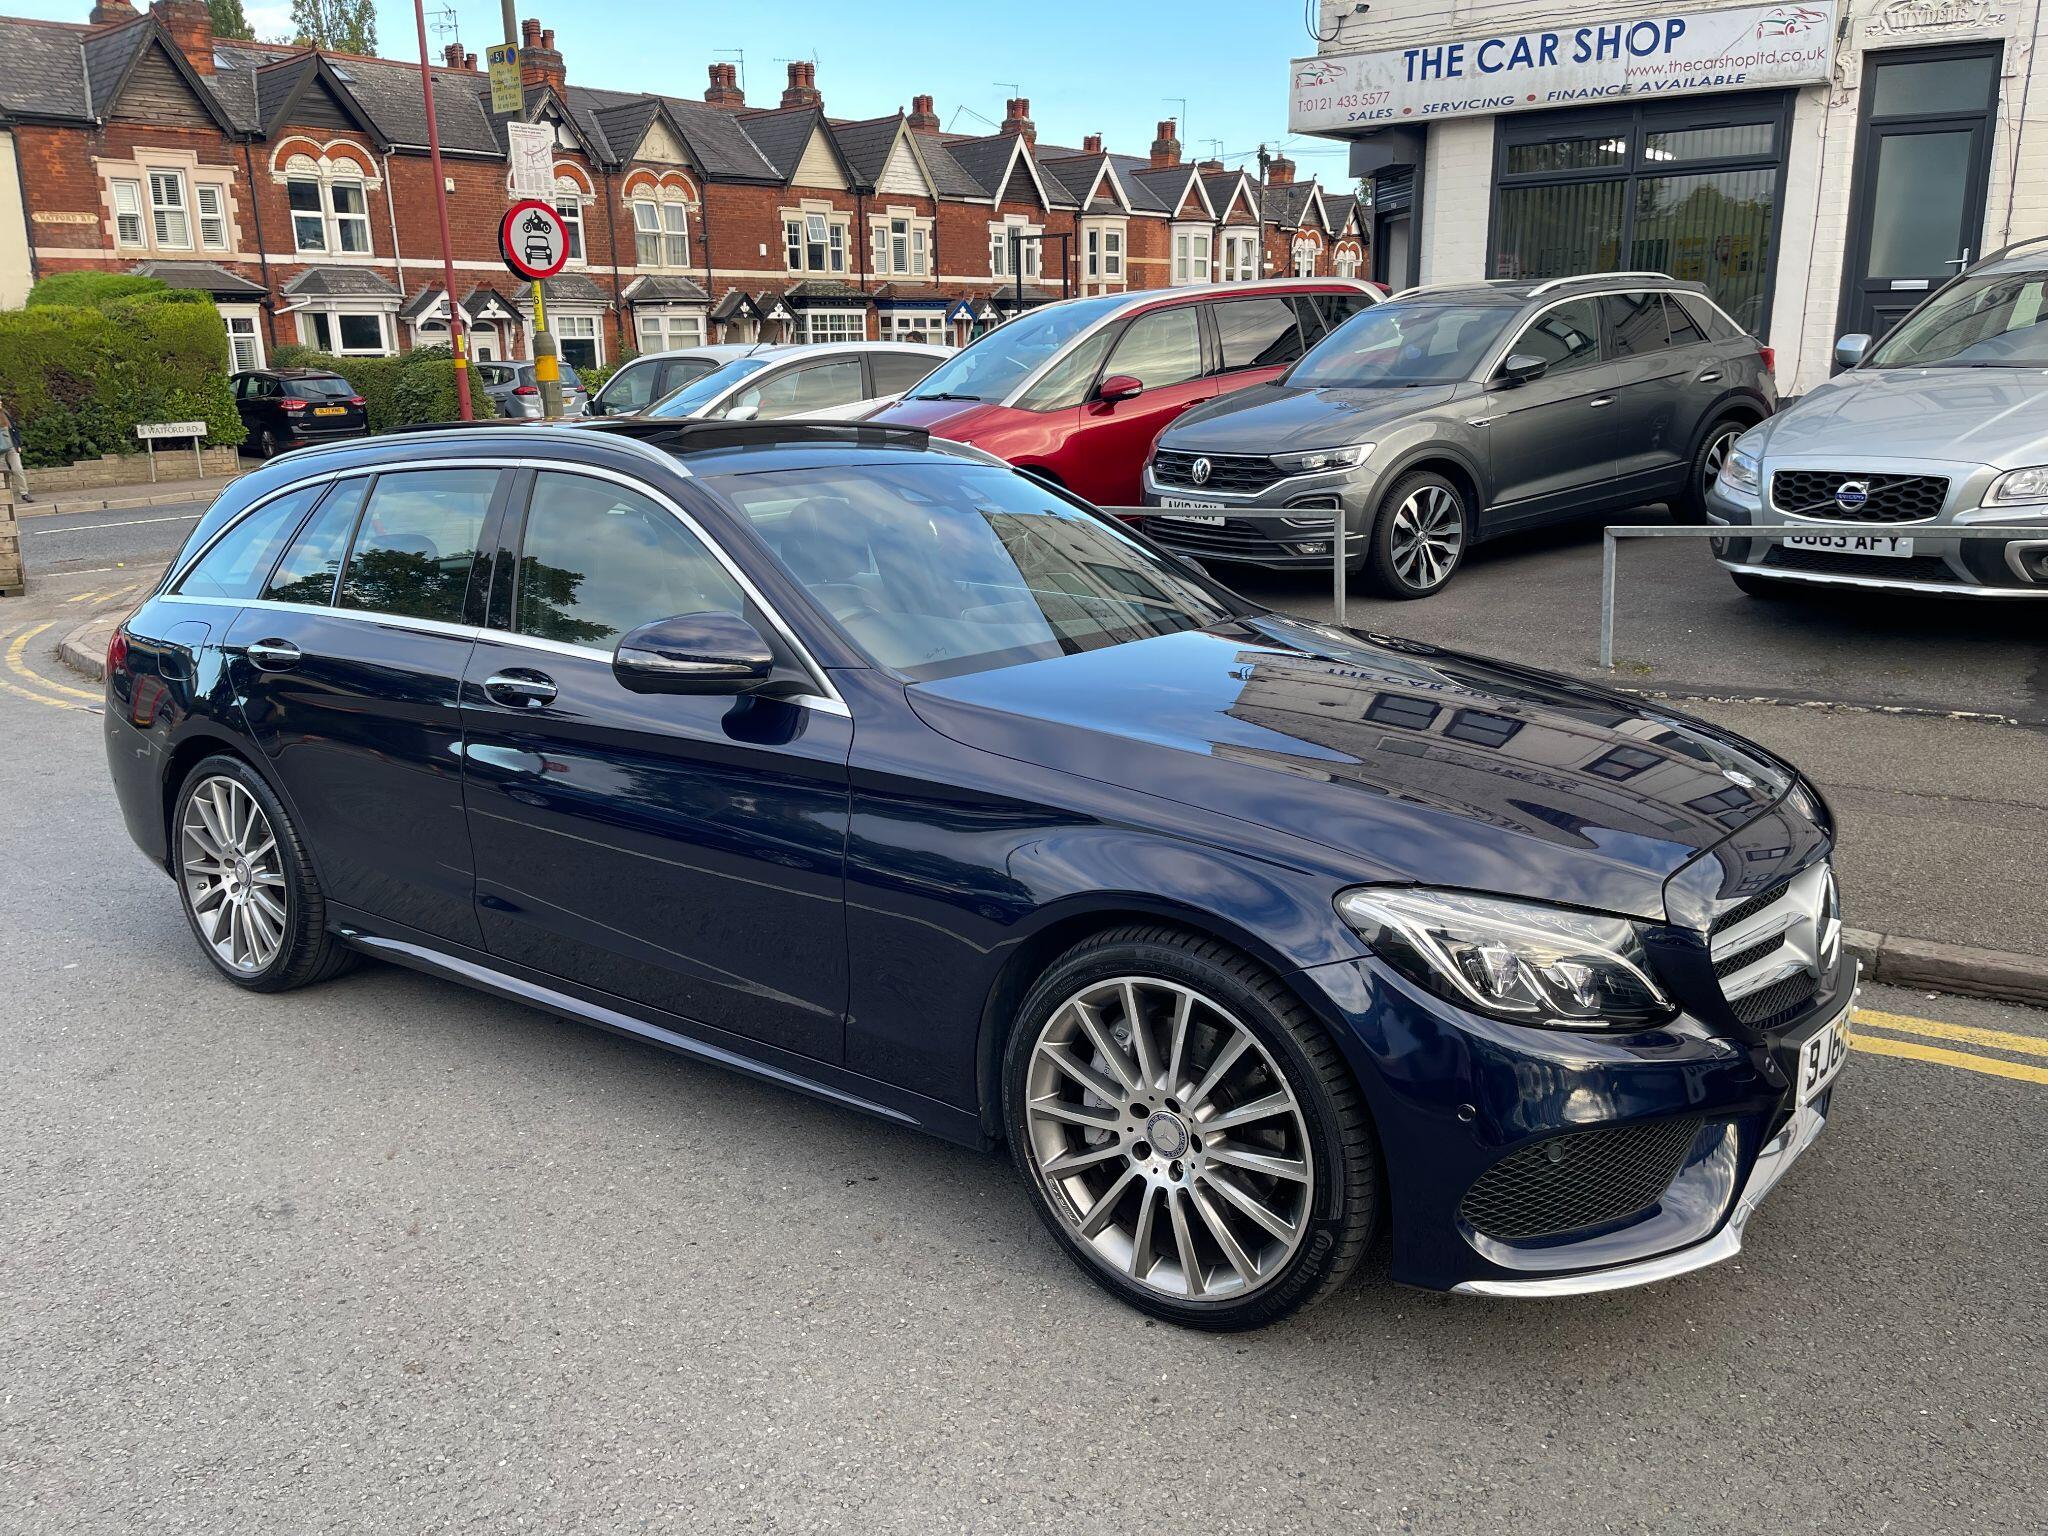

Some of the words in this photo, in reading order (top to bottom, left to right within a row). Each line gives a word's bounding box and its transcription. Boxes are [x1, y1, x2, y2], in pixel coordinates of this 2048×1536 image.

[1404, 44, 1464, 82] THE
[1477, 33, 1559, 74] CAR
[1572, 18, 1686, 64] SHOP
[1624, 47, 1825, 77] www.thecarshopltd.co.uk
[1298, 97, 1333, 112] T:0121
[1337, 93, 1358, 108] 433
[1361, 91, 1390, 106] 5577
[1347, 108, 1393, 122] SALES
[1421, 95, 1515, 114] SERVICING
[1547, 84, 1632, 101] FINANCE
[1638, 73, 1747, 93] AVAILABLE
[147, 426, 185, 434] WATFORD
